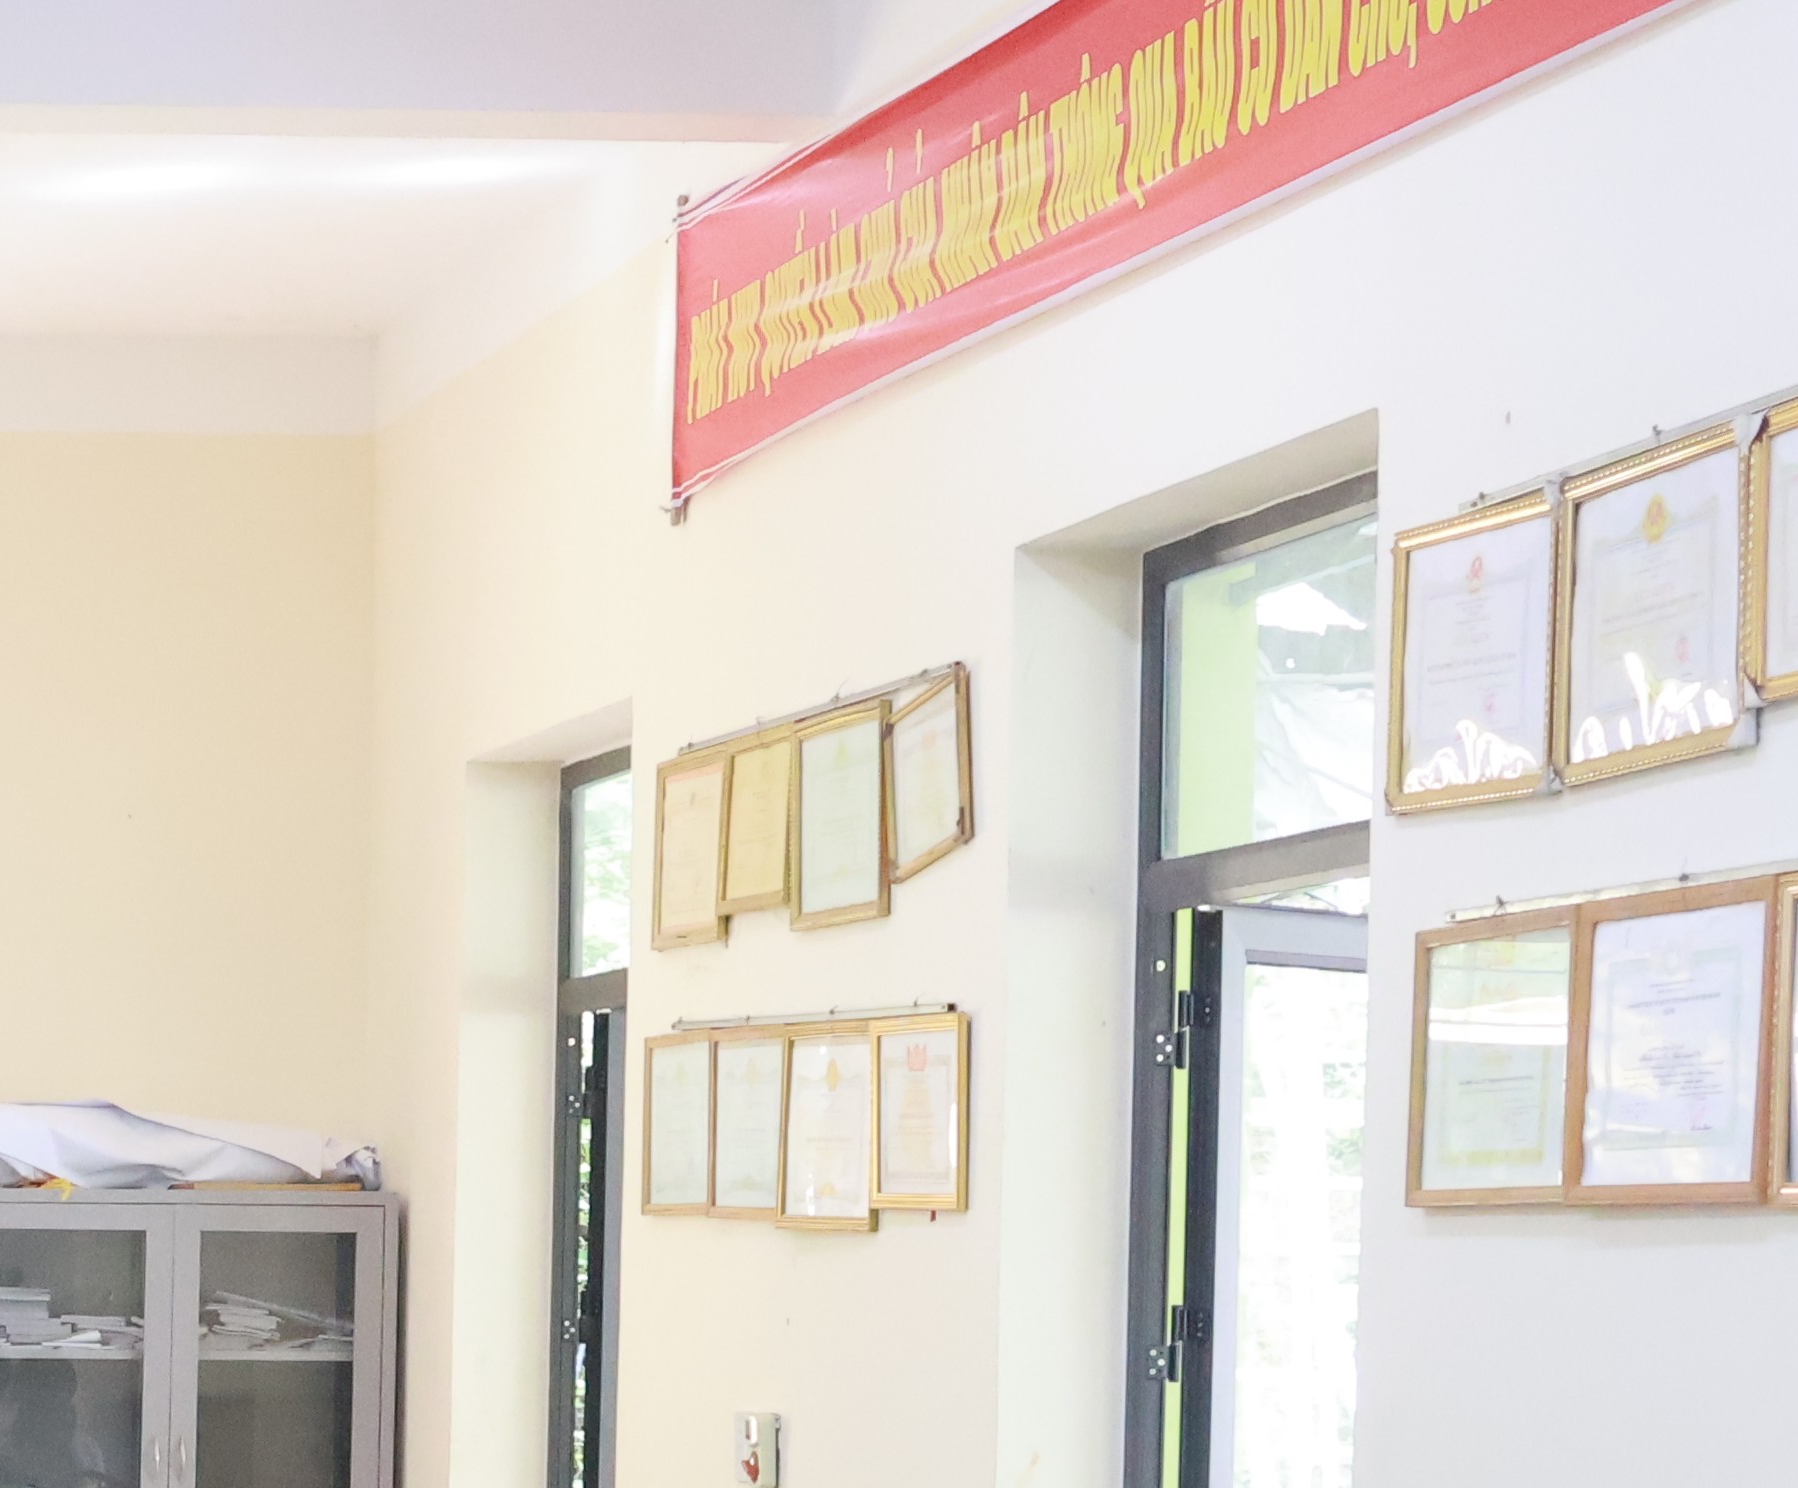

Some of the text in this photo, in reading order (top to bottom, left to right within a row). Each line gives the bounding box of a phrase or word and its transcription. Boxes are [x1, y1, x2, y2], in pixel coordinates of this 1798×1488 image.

[686, 278, 730, 425] PHÁT
[726, 279, 763, 404] HUY
[759, 208, 817, 398] QUYỀN
[814, 207, 858, 356] LÀM
[852, 145, 900, 333] CHỦ
[890, 128, 944, 314] CỦA
[934, 120, 999, 293] NHÂN
[991, 90, 1046, 263] DÂN
[1042, 52, 1125, 236] THÔNG
[1122, 29, 1178, 210] QUA
